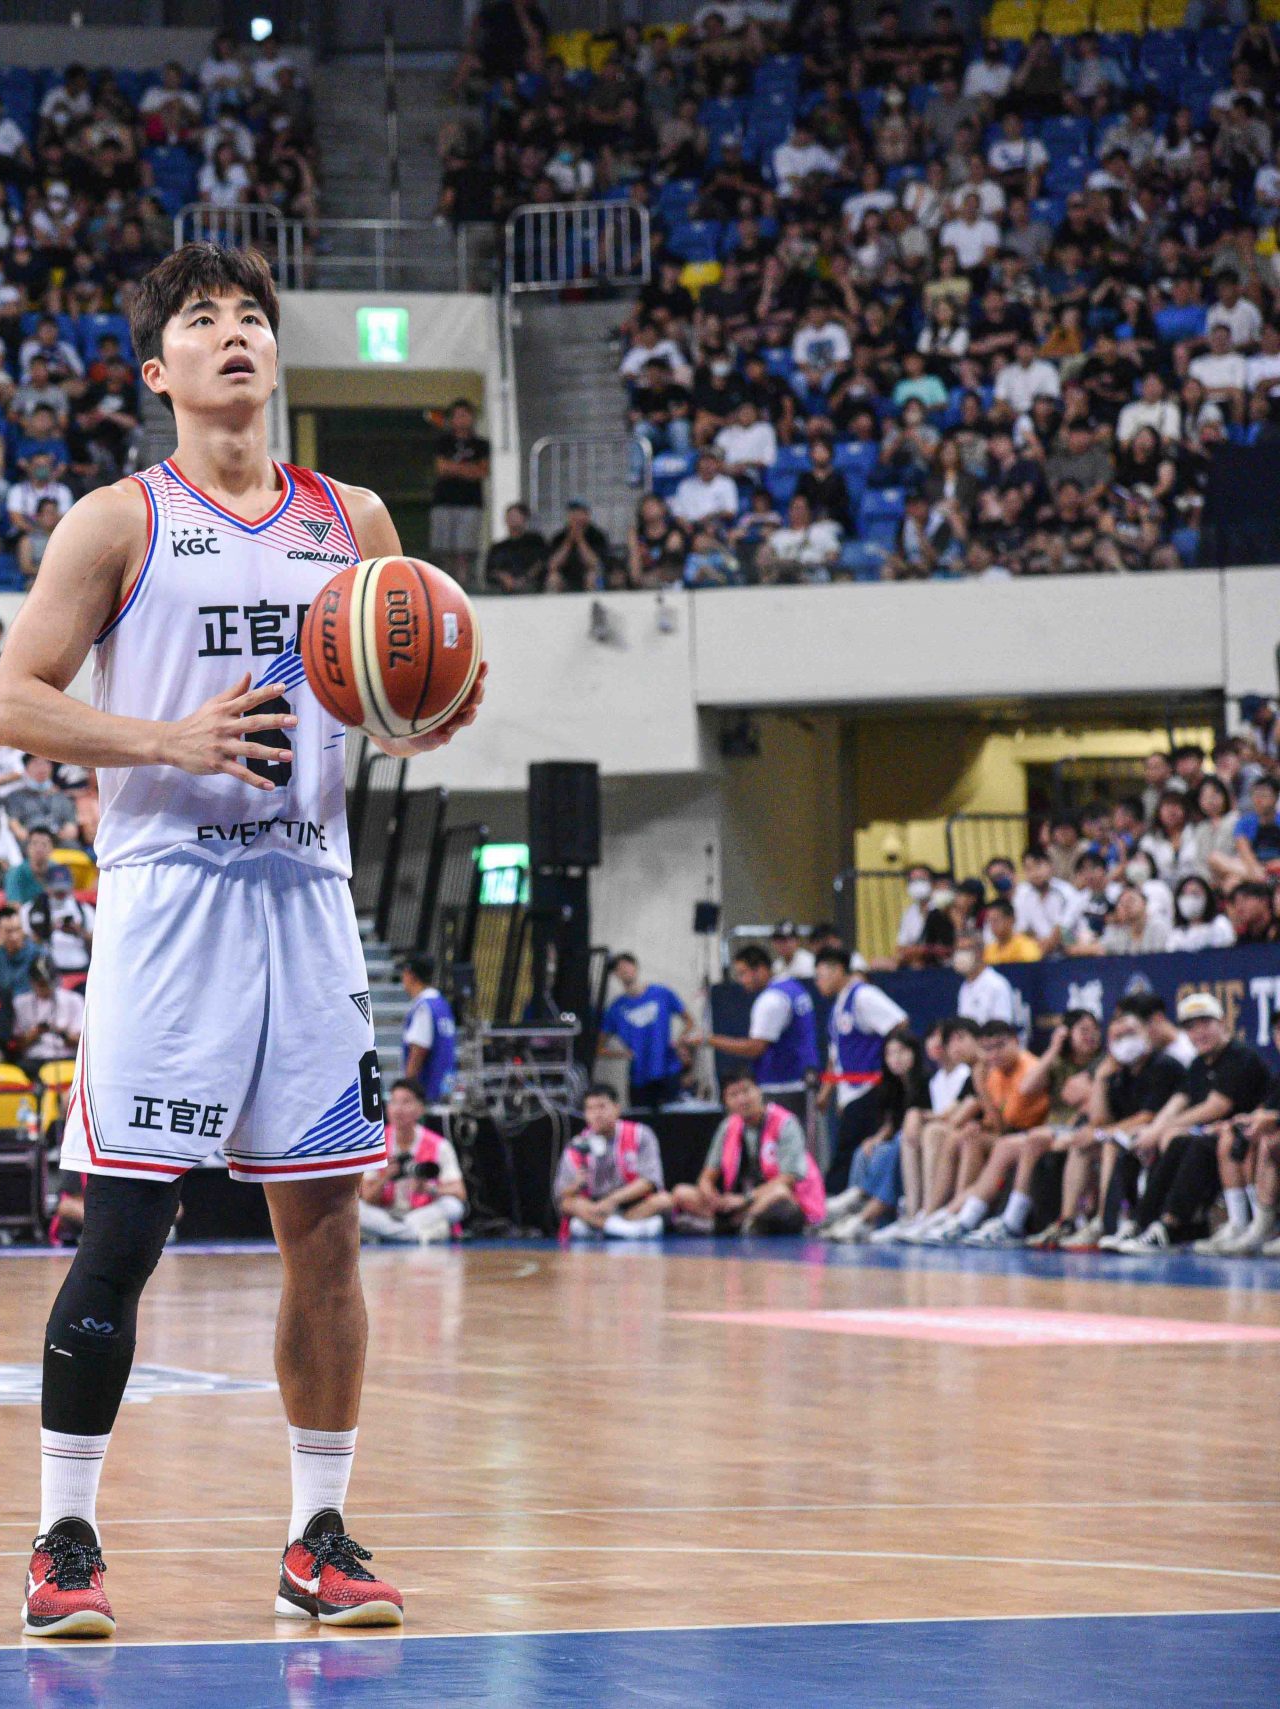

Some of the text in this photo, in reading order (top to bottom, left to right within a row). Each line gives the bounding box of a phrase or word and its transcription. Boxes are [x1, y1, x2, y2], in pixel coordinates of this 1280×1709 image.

[172, 537, 221, 557] KGC
[287, 550, 350, 565] CORALIAN
[384, 589, 413, 669] 7000
[128, 1095, 229, 1138] 正官庄
